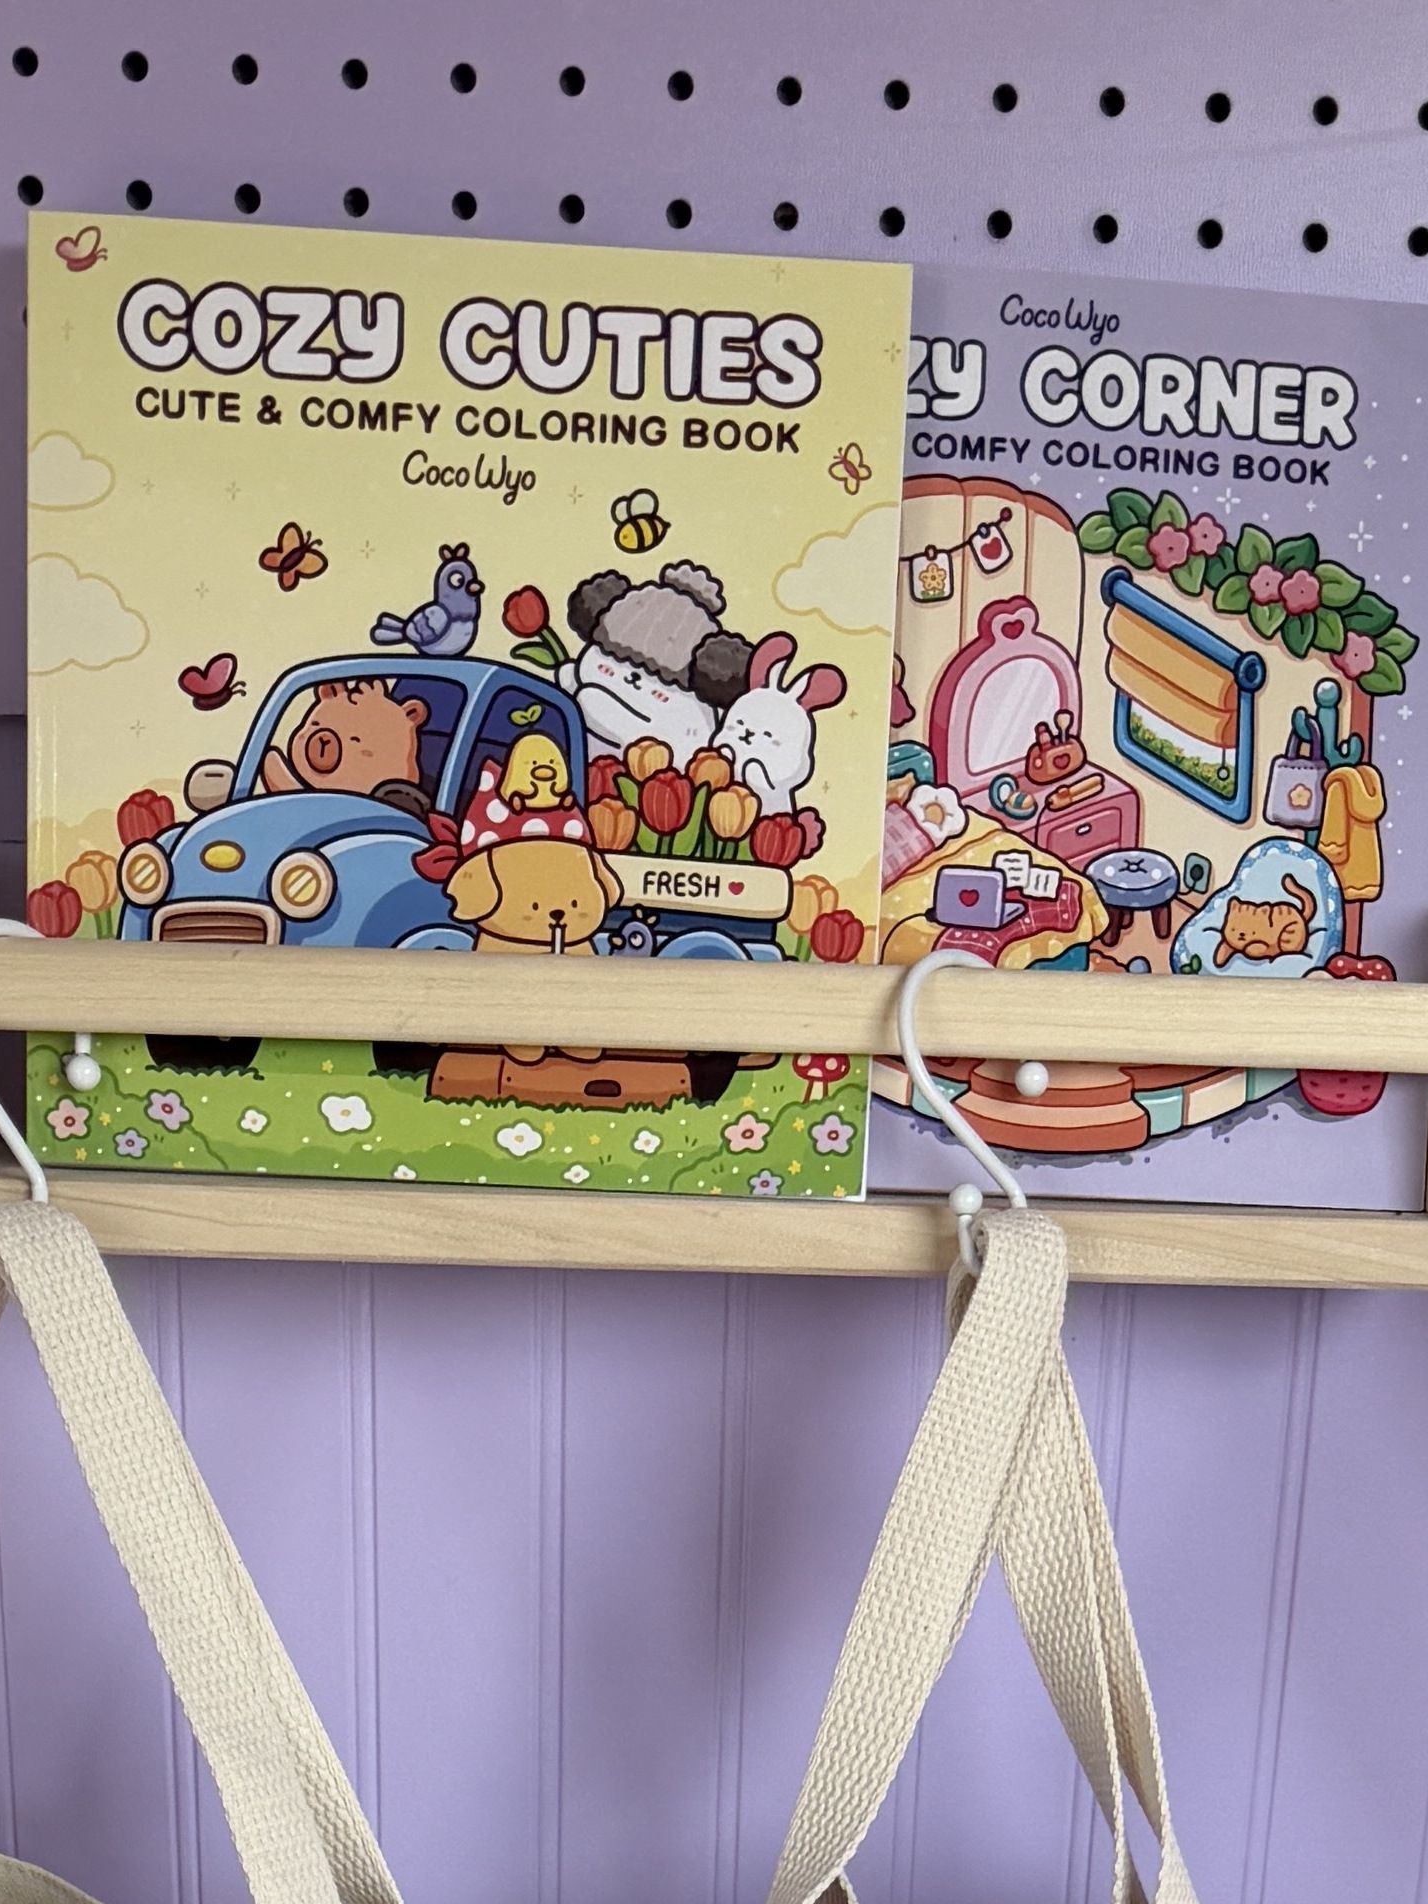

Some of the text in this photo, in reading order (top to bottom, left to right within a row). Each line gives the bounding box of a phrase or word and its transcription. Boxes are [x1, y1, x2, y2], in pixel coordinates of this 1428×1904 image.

[118, 278, 823, 409] COZY CUTIES
[134, 386, 800, 454] CUTE COMFY COLORING BOOK
[1020, 345, 1358, 450] CORNER
[643, 871, 720, 897] FRESH
